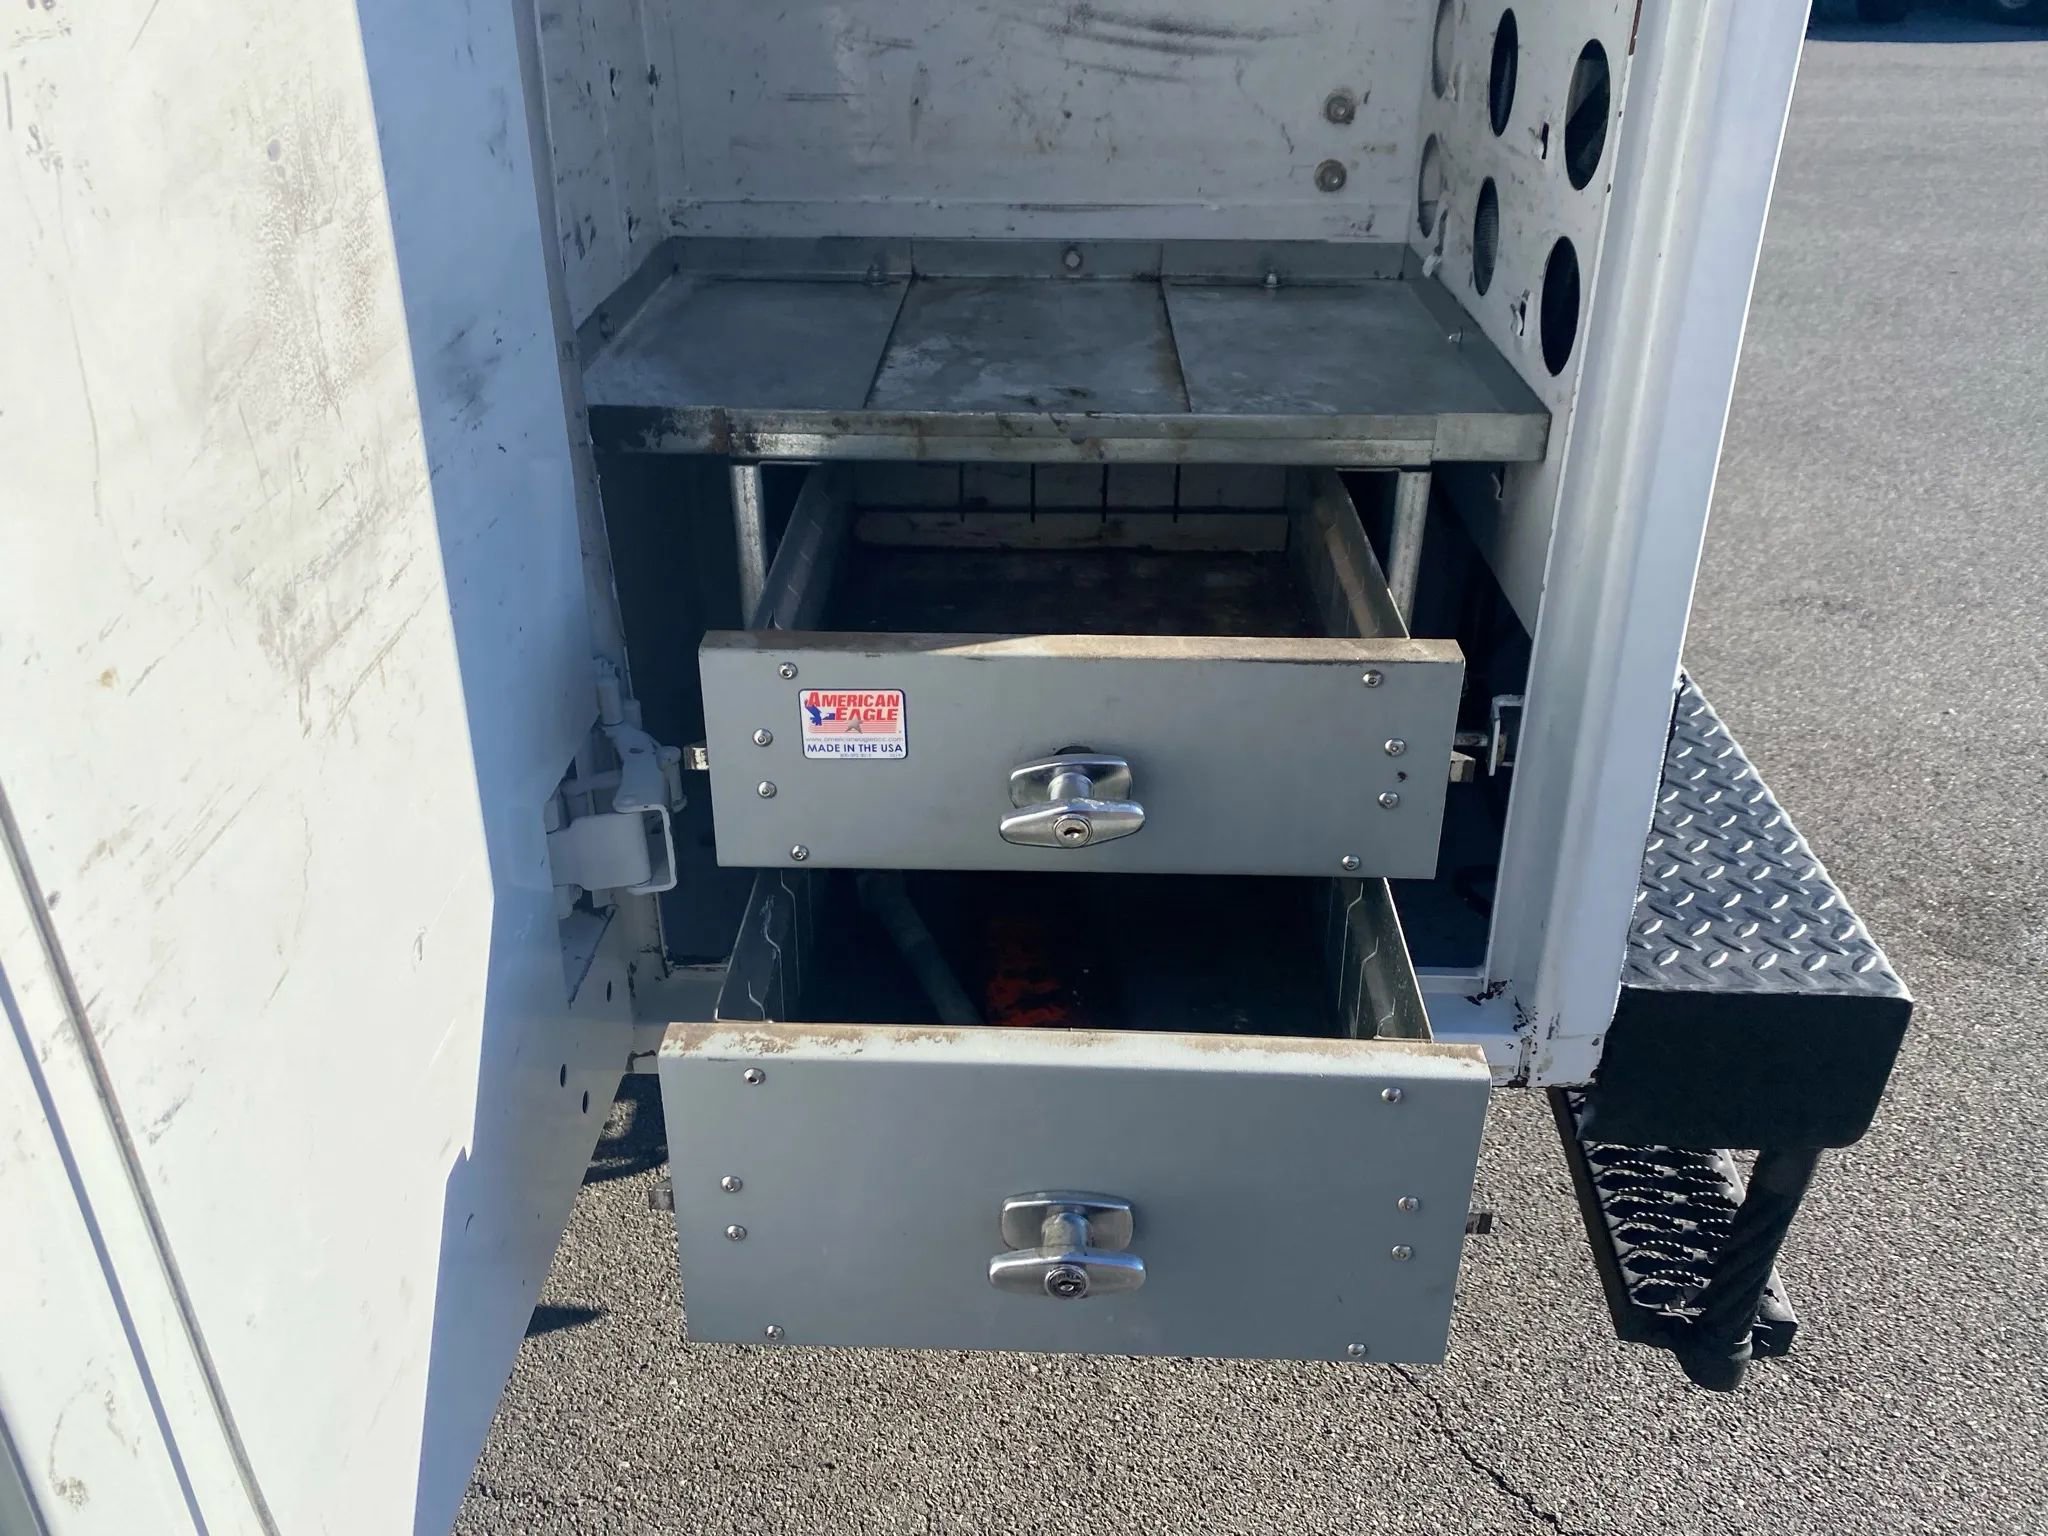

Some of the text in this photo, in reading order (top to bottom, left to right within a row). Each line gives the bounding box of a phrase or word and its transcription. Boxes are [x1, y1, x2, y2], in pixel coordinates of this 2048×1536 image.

[808, 692, 899, 707] AMERICAN
[835, 708, 898, 721] EAGLE
[807, 744, 903, 752] MADE IN THE USA
